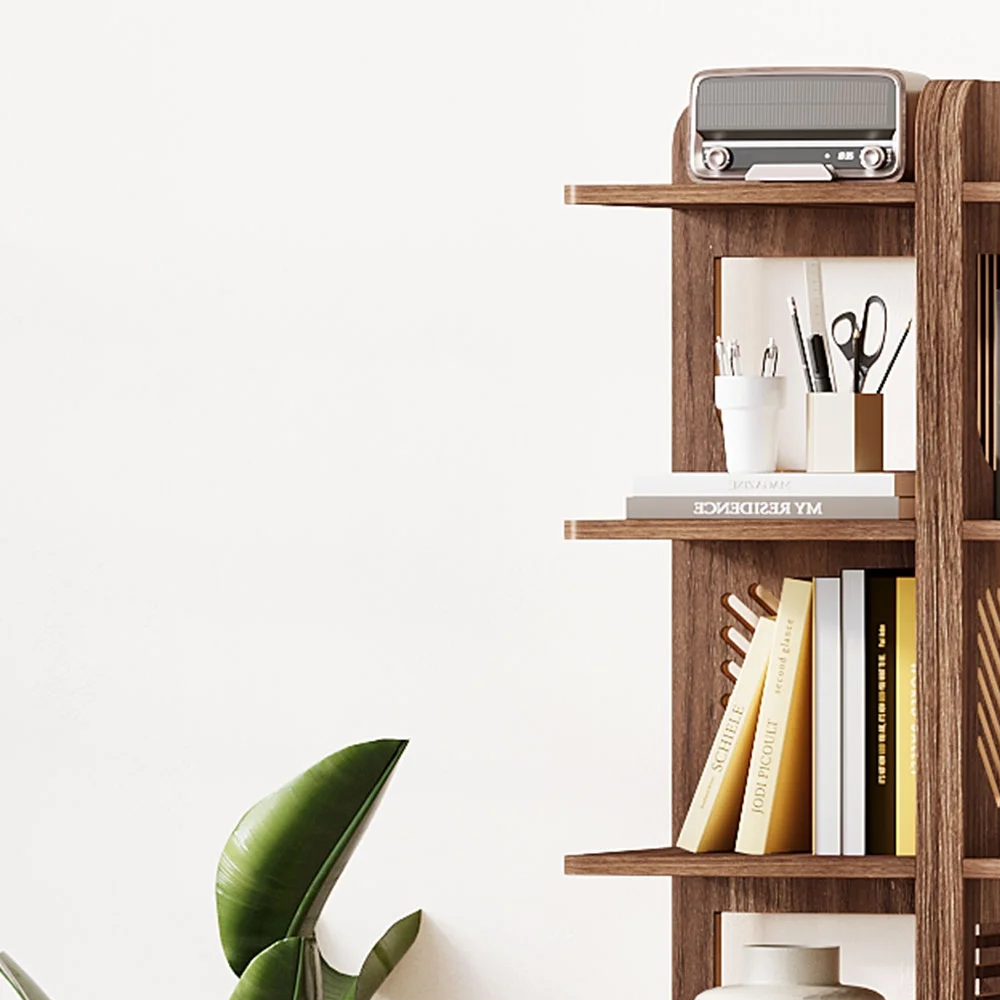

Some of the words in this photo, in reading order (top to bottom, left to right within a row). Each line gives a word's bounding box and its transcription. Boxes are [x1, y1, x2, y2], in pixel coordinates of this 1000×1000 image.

[780, 618, 794, 654] glance
[775, 657, 787, 694] second
[711, 703, 745, 773] SCHIELE
[758, 719, 778, 779] PICOULT
[751, 780, 767, 814] JODI
